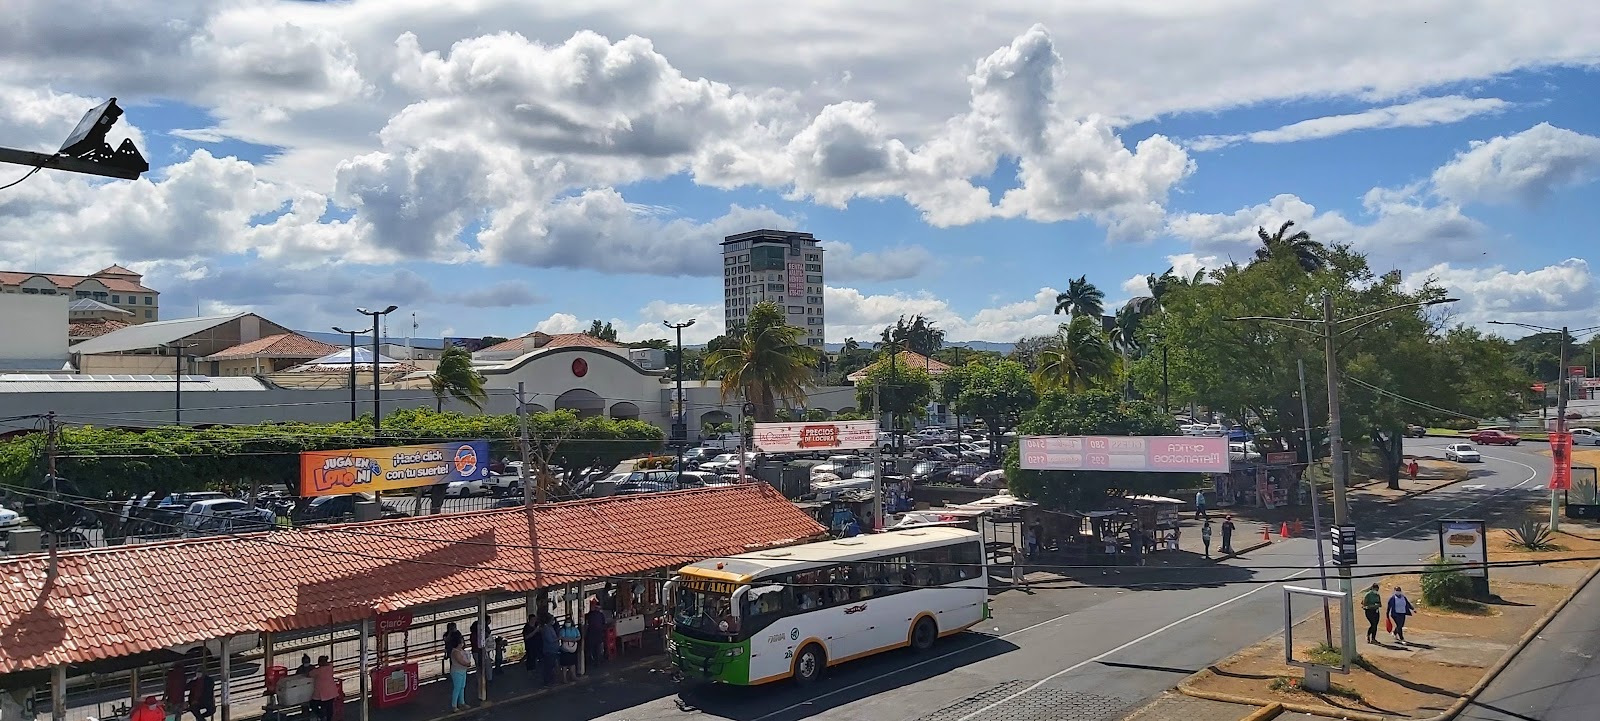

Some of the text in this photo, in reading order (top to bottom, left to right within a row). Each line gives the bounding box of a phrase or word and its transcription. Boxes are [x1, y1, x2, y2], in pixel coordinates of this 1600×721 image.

[805, 428, 834, 437] PRECIOS
[323, 453, 370, 470] JUGÁ EN
[393, 450, 443, 467] ¡Hacé click
[386, 470, 404, 481] con
[405, 467, 417, 479] tu
[417, 464, 449, 479] suerte!
[380, 619, 402, 630] Claro
